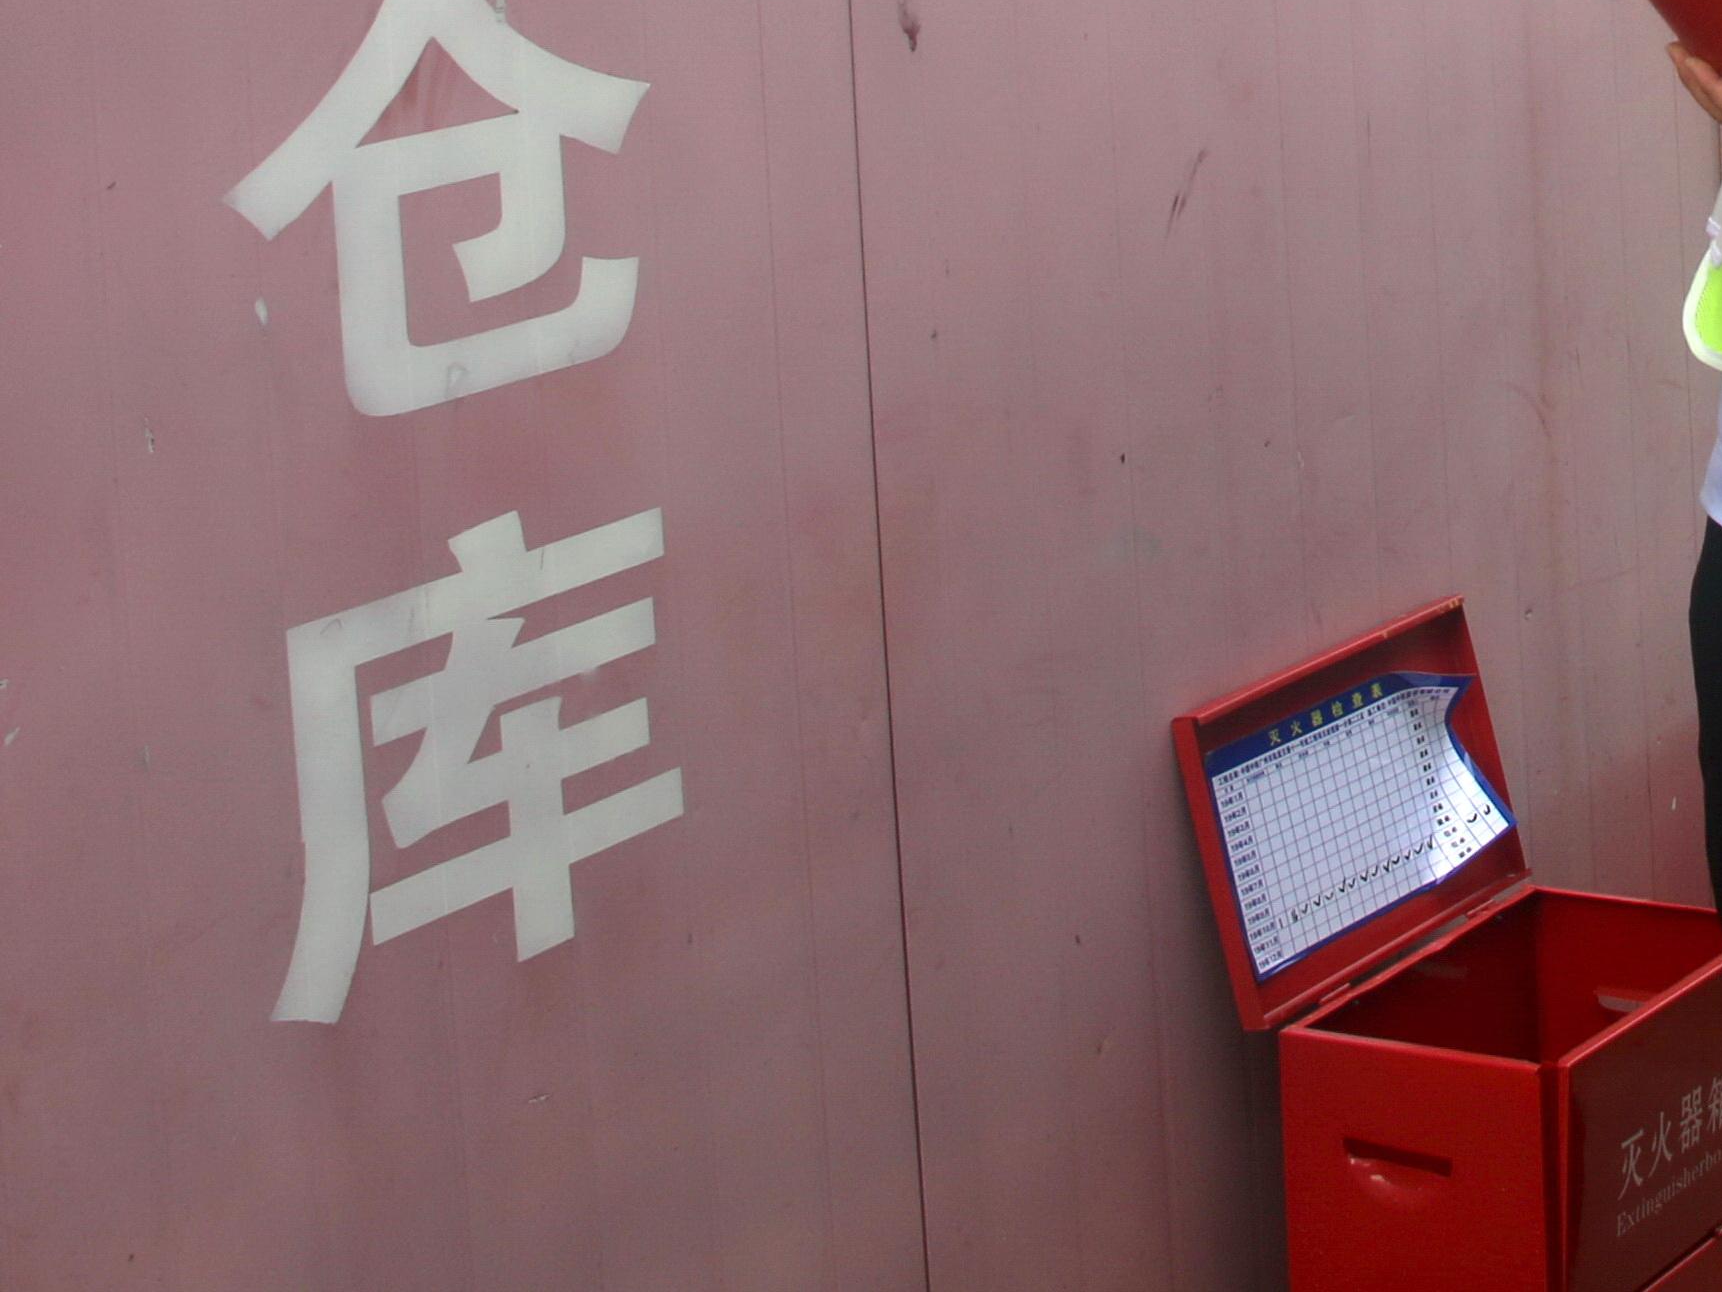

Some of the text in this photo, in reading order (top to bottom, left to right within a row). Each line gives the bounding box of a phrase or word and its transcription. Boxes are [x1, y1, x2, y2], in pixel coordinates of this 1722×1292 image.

[1268, 682, 1383, 746] 灭火器检查表
